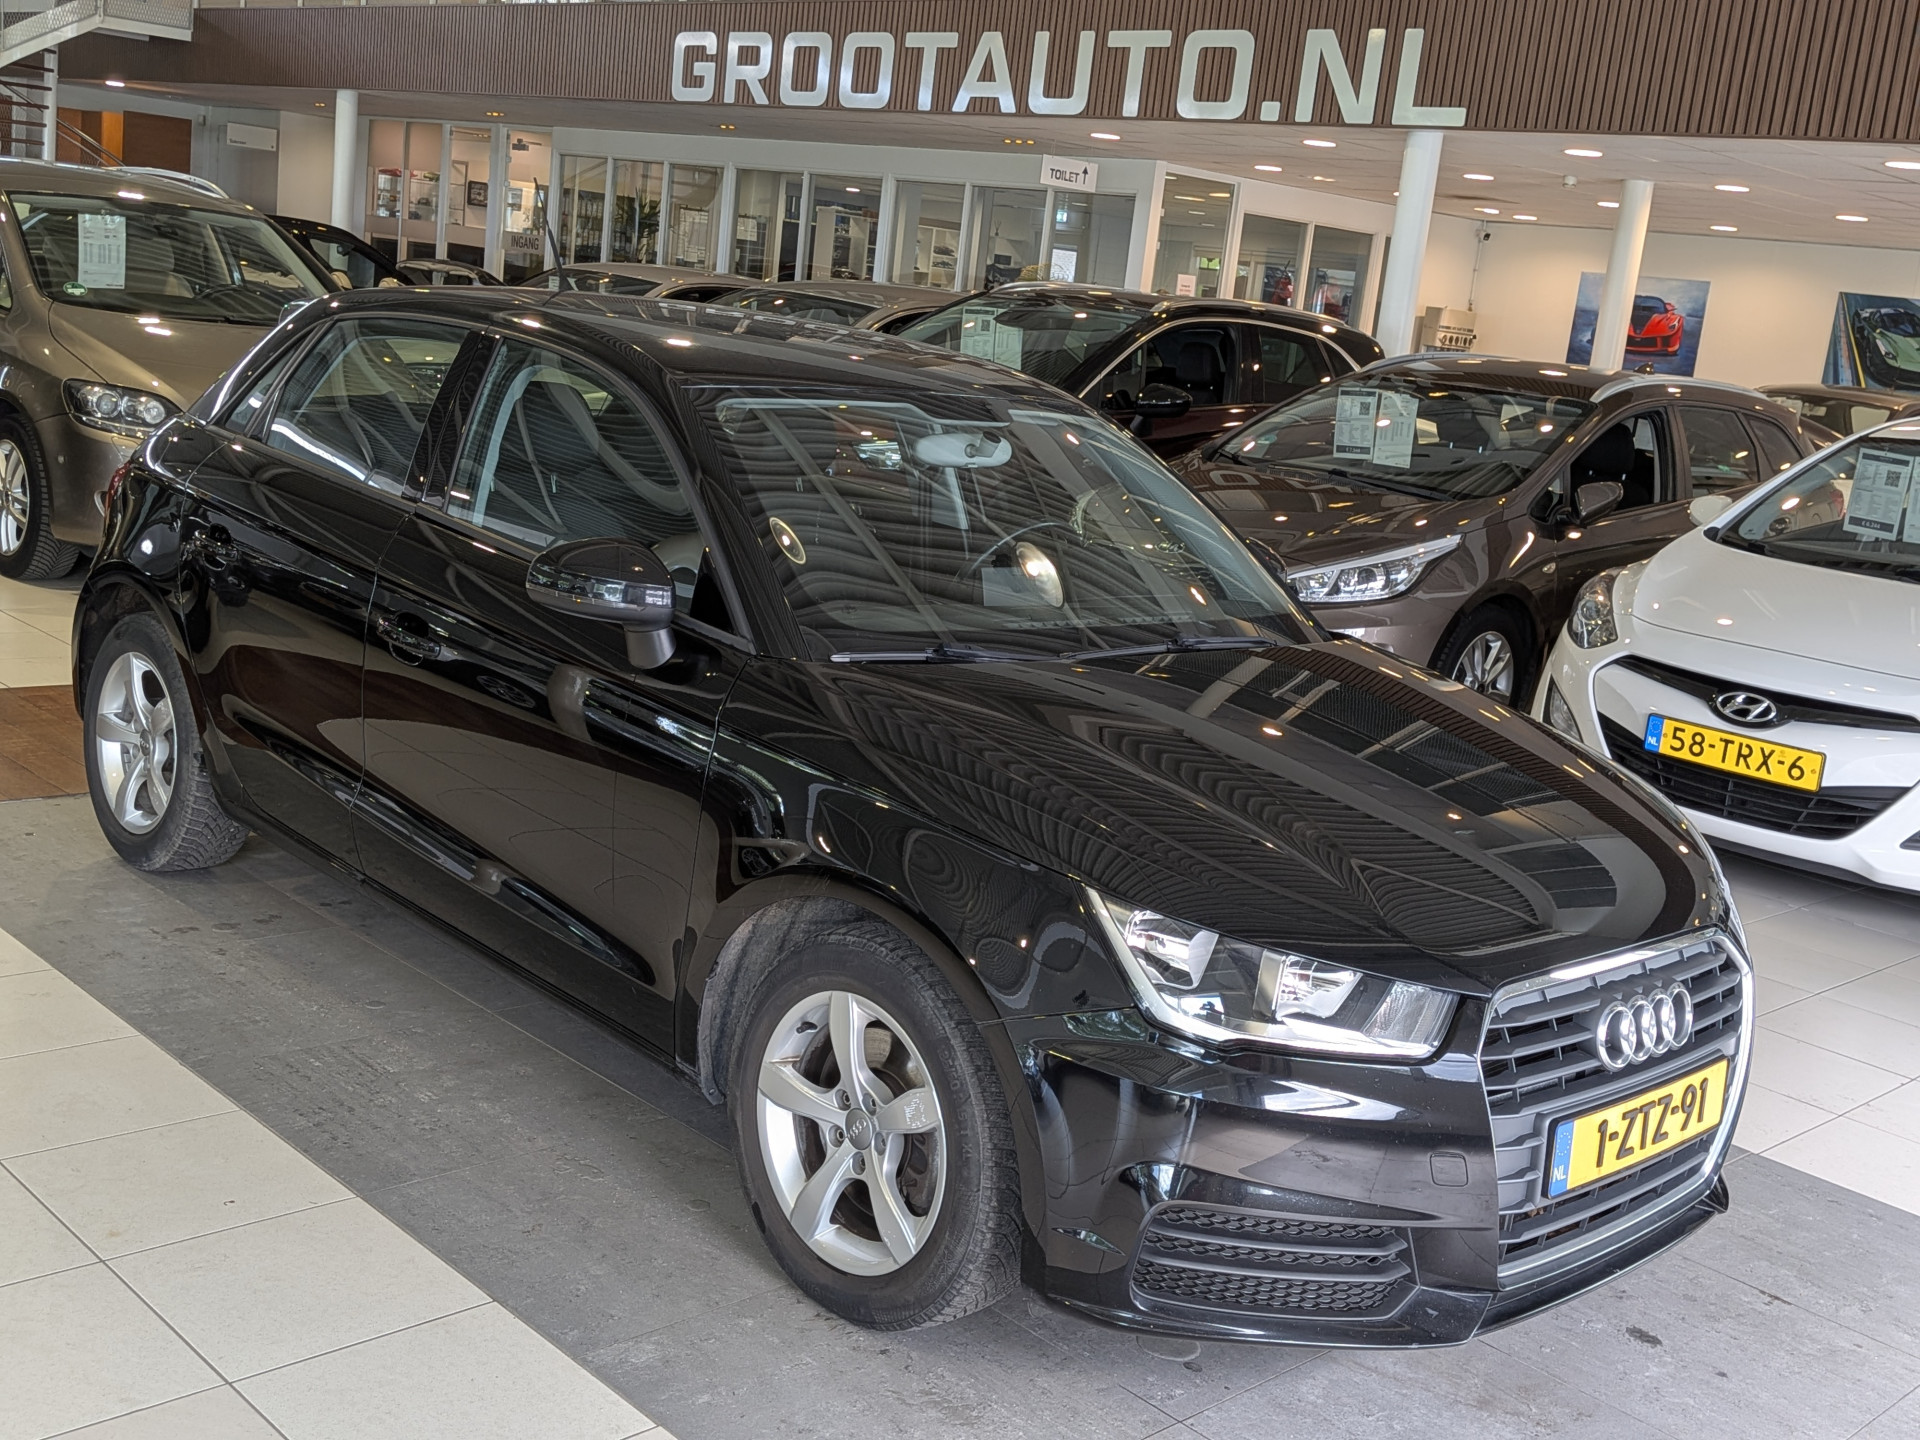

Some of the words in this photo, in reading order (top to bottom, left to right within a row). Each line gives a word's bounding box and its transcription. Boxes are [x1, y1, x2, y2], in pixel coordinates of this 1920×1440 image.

[671, 28, 1467, 126] GROOTAUTO.NL
[1050, 168, 1080, 183] TOILET
[511, 235, 540, 250] INGANG
[1647, 735, 1659, 746] NL
[1669, 726, 1805, 781] 58-TRX-6
[1596, 1077, 1709, 1168] 1-ZTZ-91
[1553, 1165, 1566, 1183] NL
